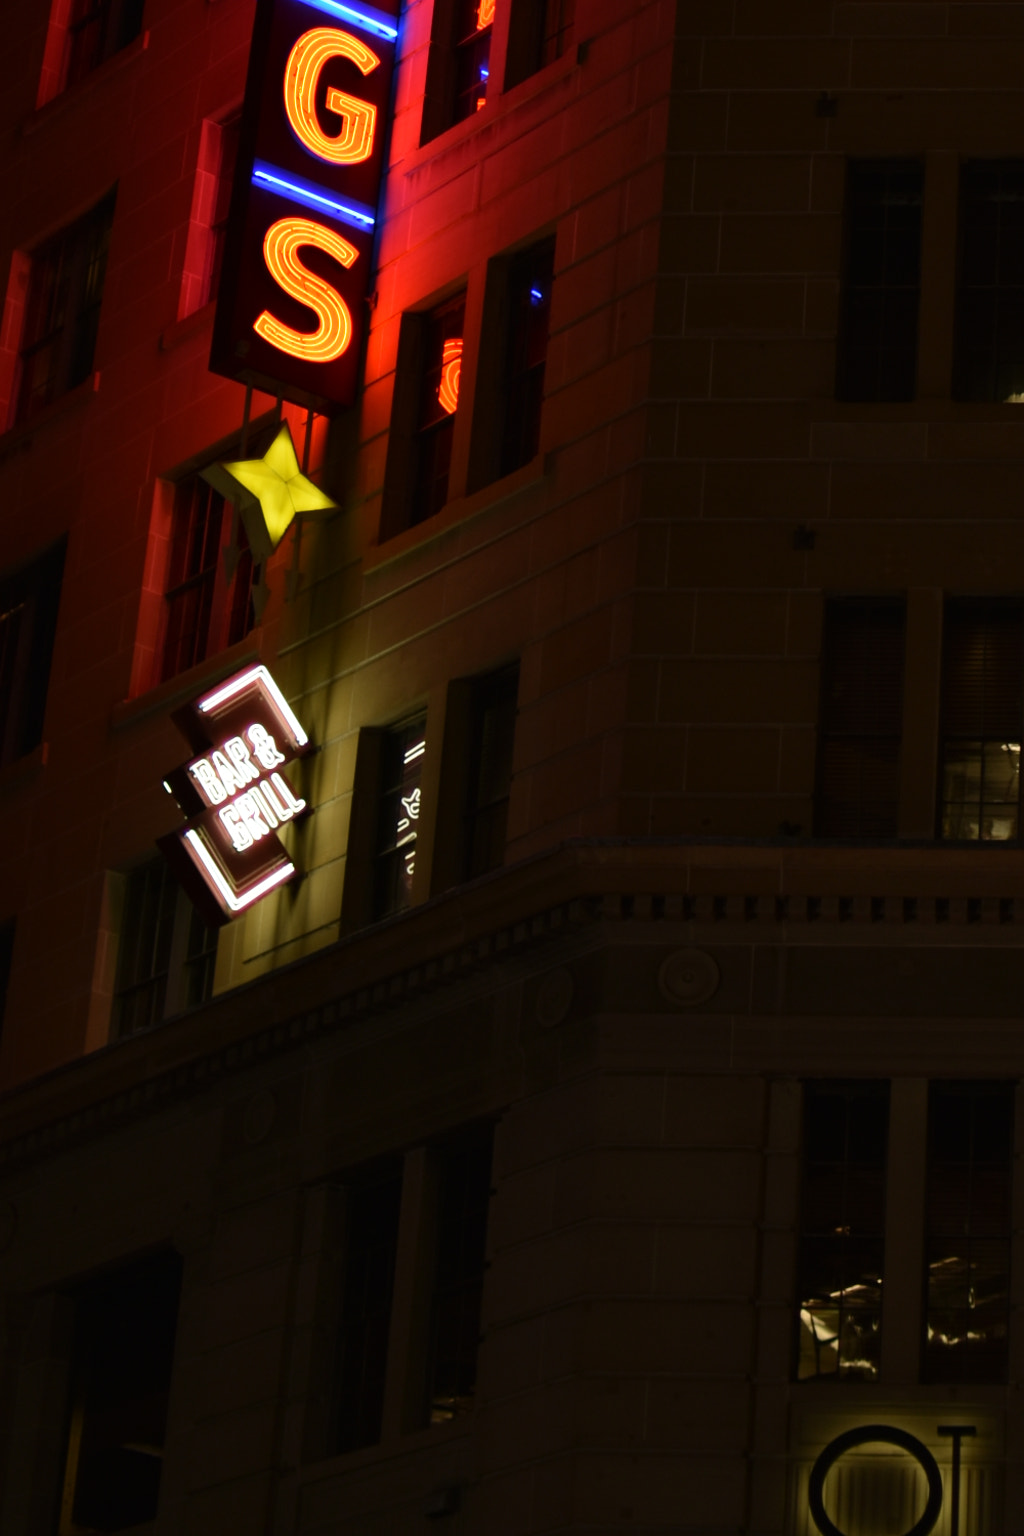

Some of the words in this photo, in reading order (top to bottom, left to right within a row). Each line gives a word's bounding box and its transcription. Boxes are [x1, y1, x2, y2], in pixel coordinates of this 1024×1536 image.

[189, 736, 260, 806] BAR
[247, 723, 286, 770] &
[219, 772, 307, 852] GRILL
